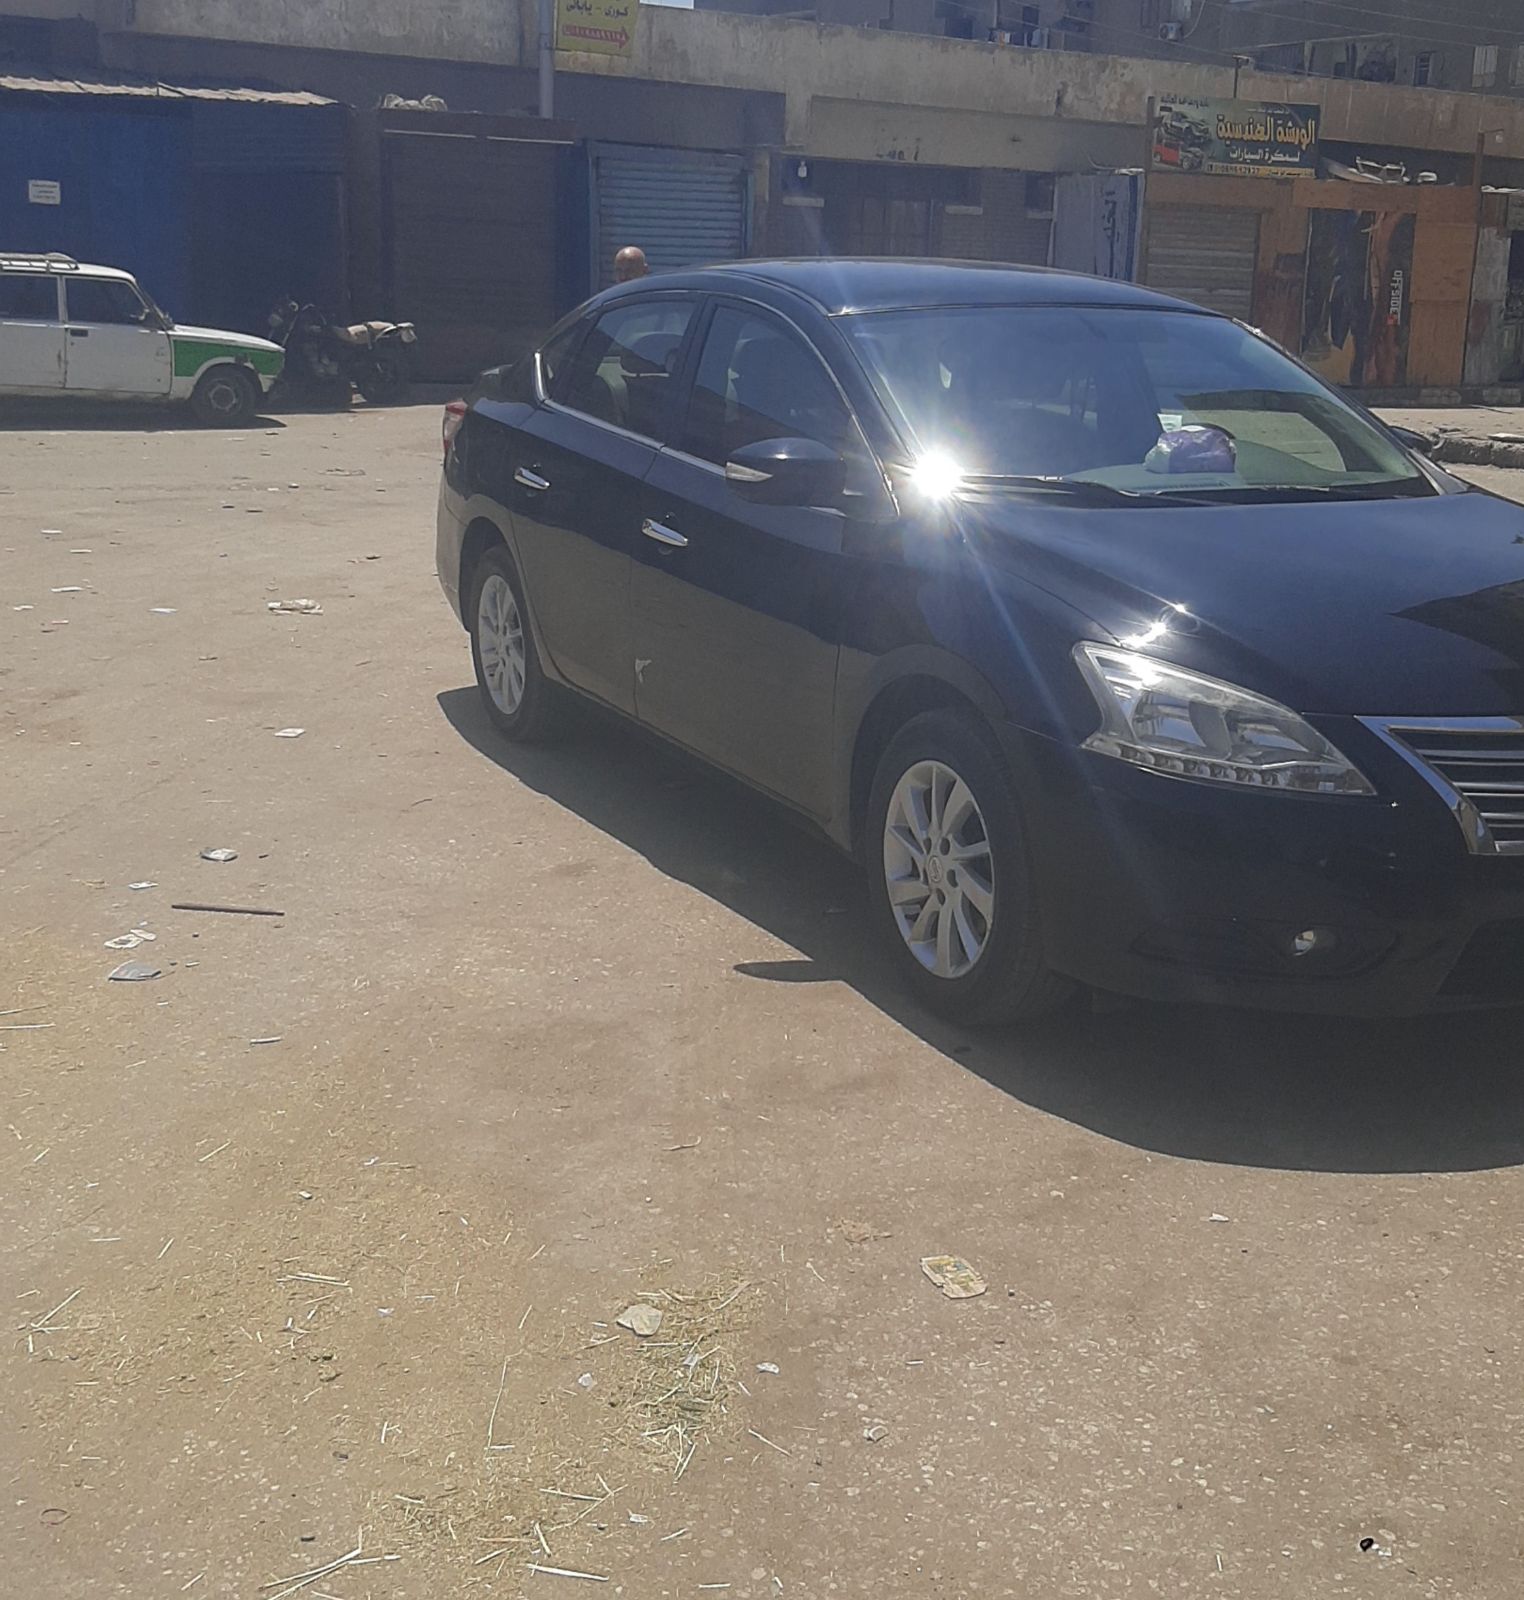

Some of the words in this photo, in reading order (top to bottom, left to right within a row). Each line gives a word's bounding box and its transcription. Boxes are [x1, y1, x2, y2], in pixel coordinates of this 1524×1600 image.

[1217, 113, 1273, 146] الهندسية
[1276, 118, 1315, 150] الورشة
[1229, 144, 1263, 162] السيارات
[1265, 146, 1300, 162] لسمكرة
